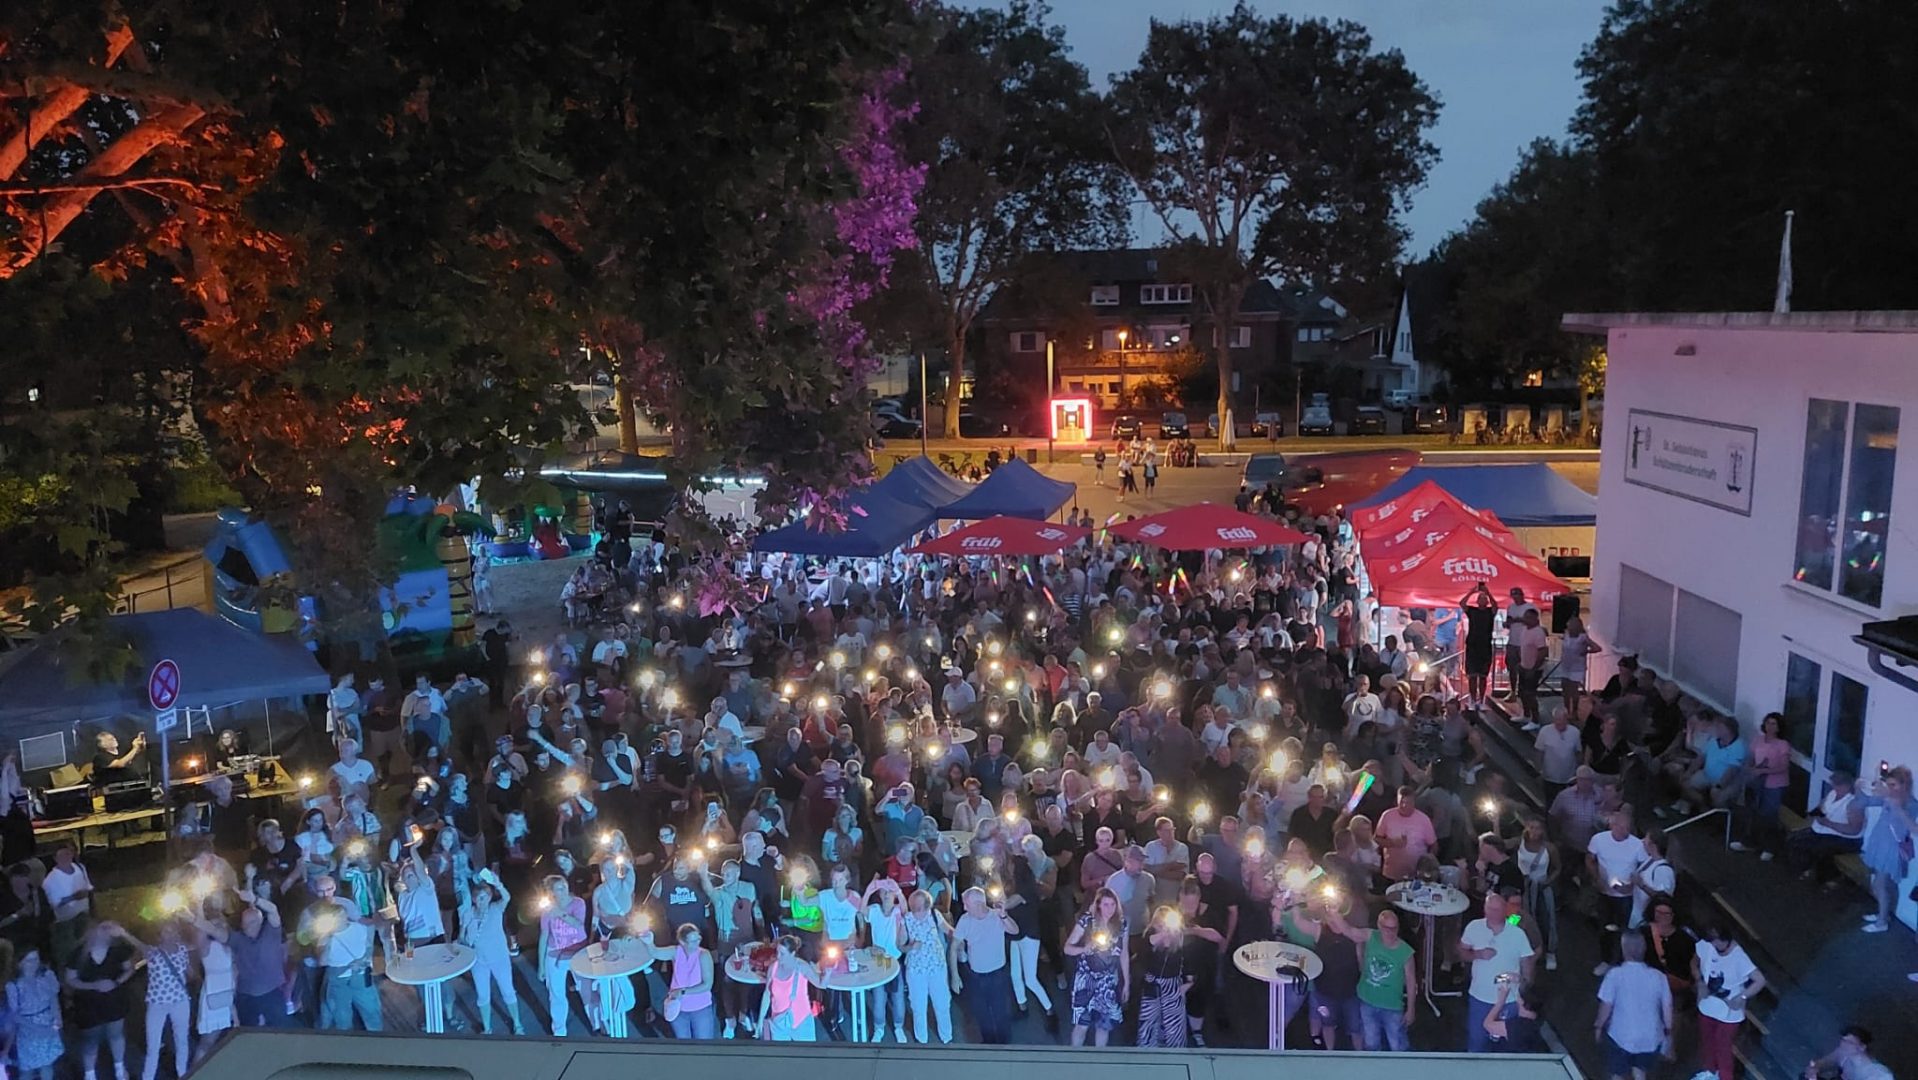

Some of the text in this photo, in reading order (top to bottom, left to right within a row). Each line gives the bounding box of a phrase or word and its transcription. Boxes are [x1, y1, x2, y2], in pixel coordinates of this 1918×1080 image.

[1216, 526, 1257, 540] früh
[961, 536, 1002, 548] früh
[1441, 557, 1498, 578] früh
